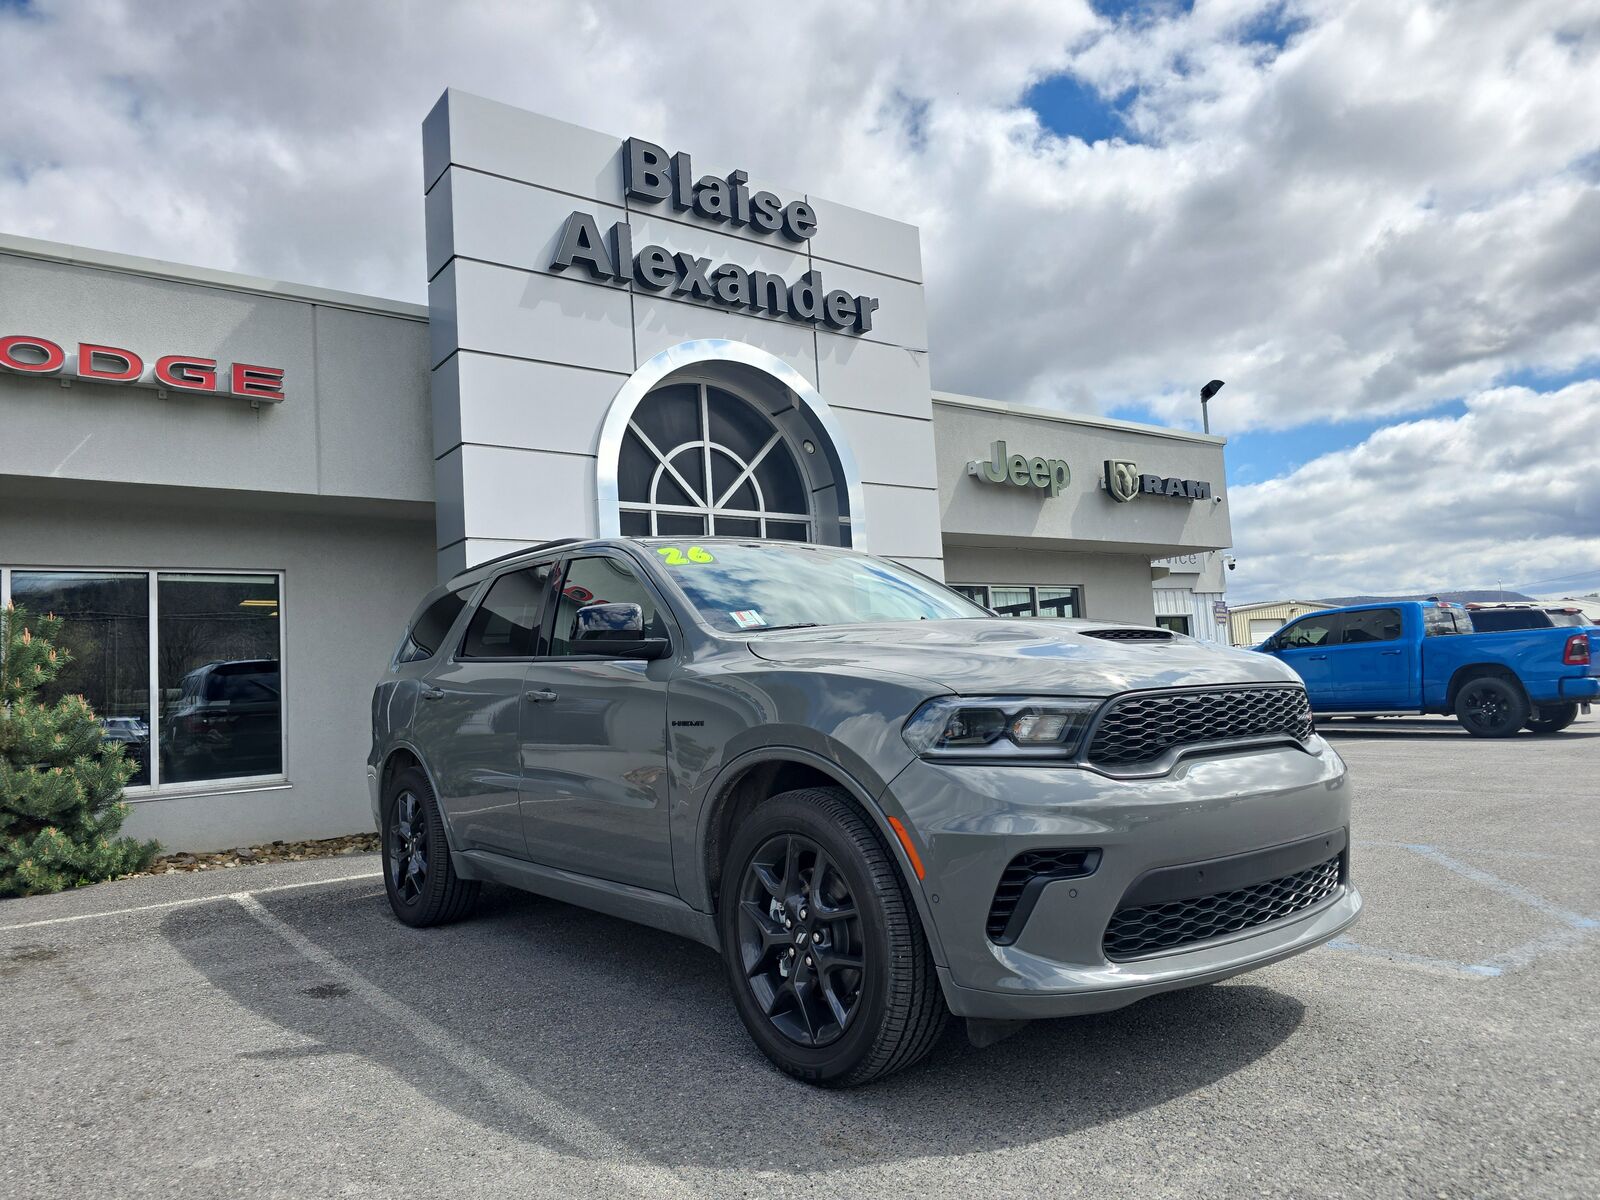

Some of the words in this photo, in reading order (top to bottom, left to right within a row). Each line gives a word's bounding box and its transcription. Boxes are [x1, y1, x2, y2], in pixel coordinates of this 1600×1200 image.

[623, 137, 818, 242] Blaise
[549, 210, 880, 334] Alexander
[976, 440, 1071, 498] Jeep
[1139, 474, 1211, 500] RAM
[656, 546, 714, 566] 26
